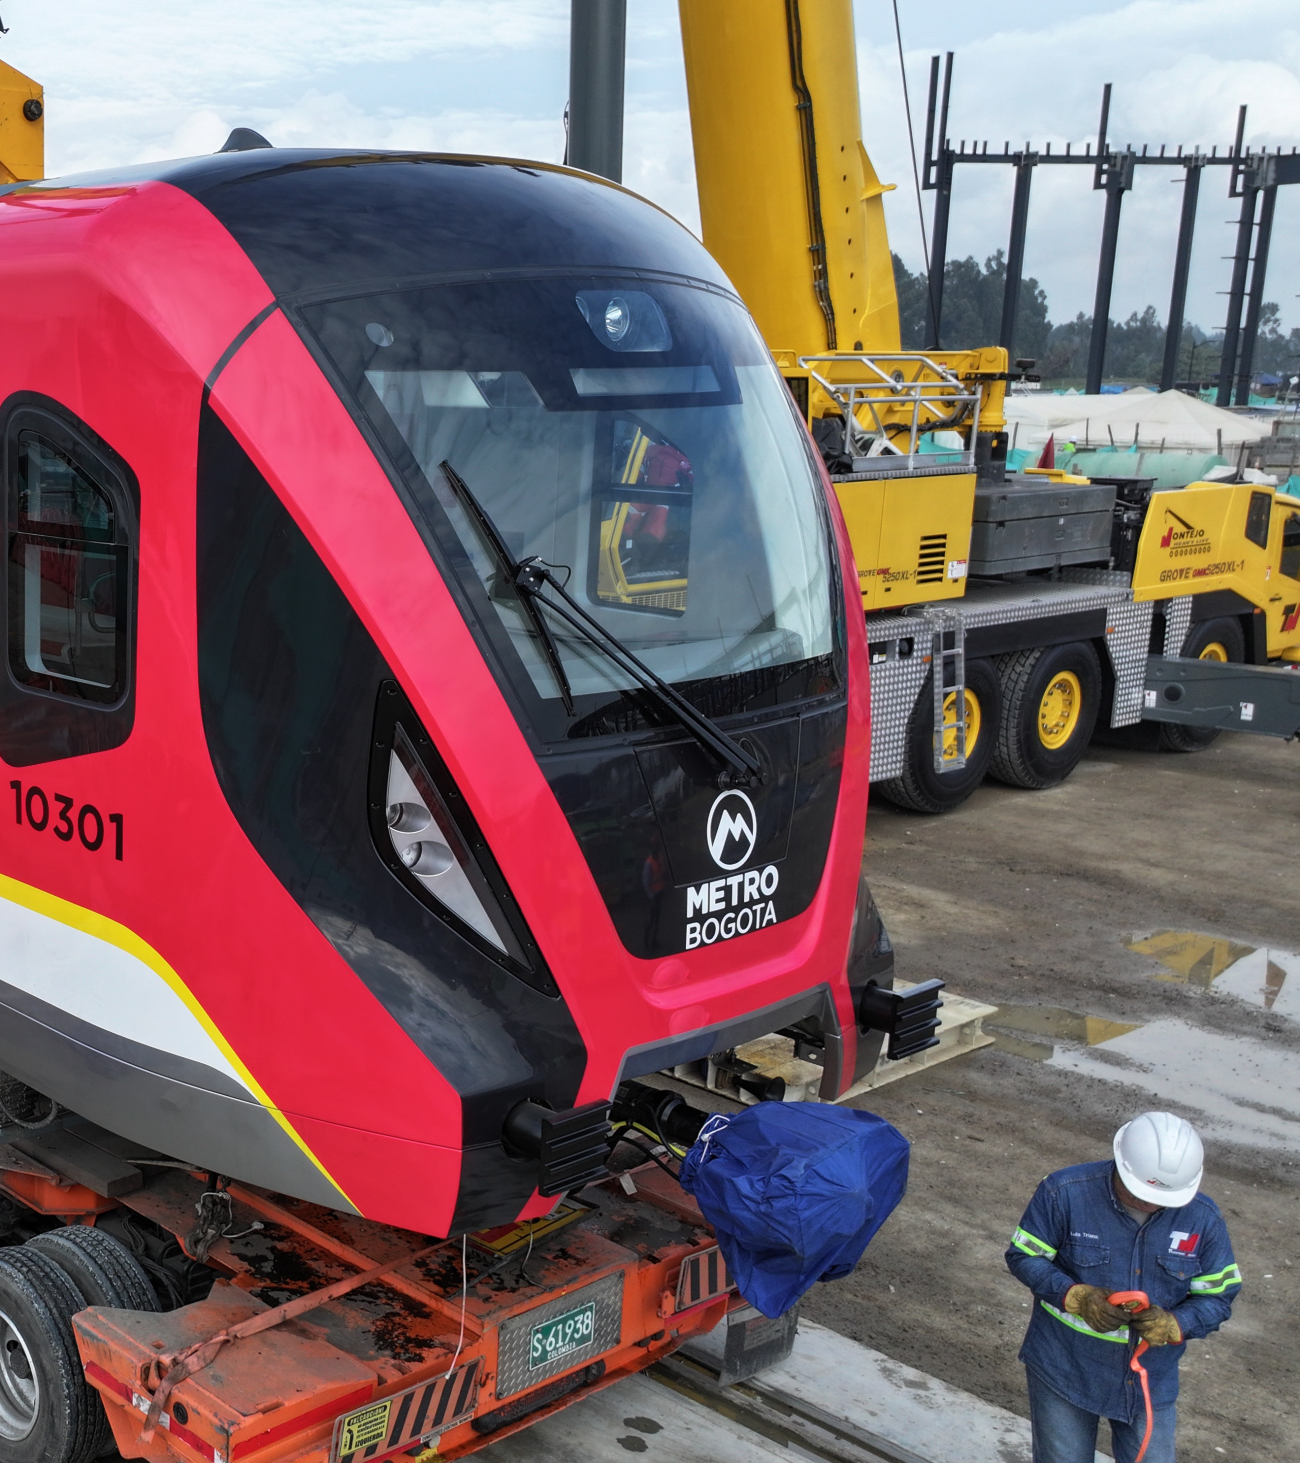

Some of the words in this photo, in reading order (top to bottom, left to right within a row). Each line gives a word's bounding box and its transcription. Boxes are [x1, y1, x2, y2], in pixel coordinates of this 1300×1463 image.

[876, 567, 891, 576] GMK
[1160, 567, 1192, 582] GROVE
[9, 780, 124, 862] 10301
[686, 865, 779, 919] METRO
[685, 900, 777, 950] BOGOTA
[547, 1342, 576, 1360] COLOMBIA
